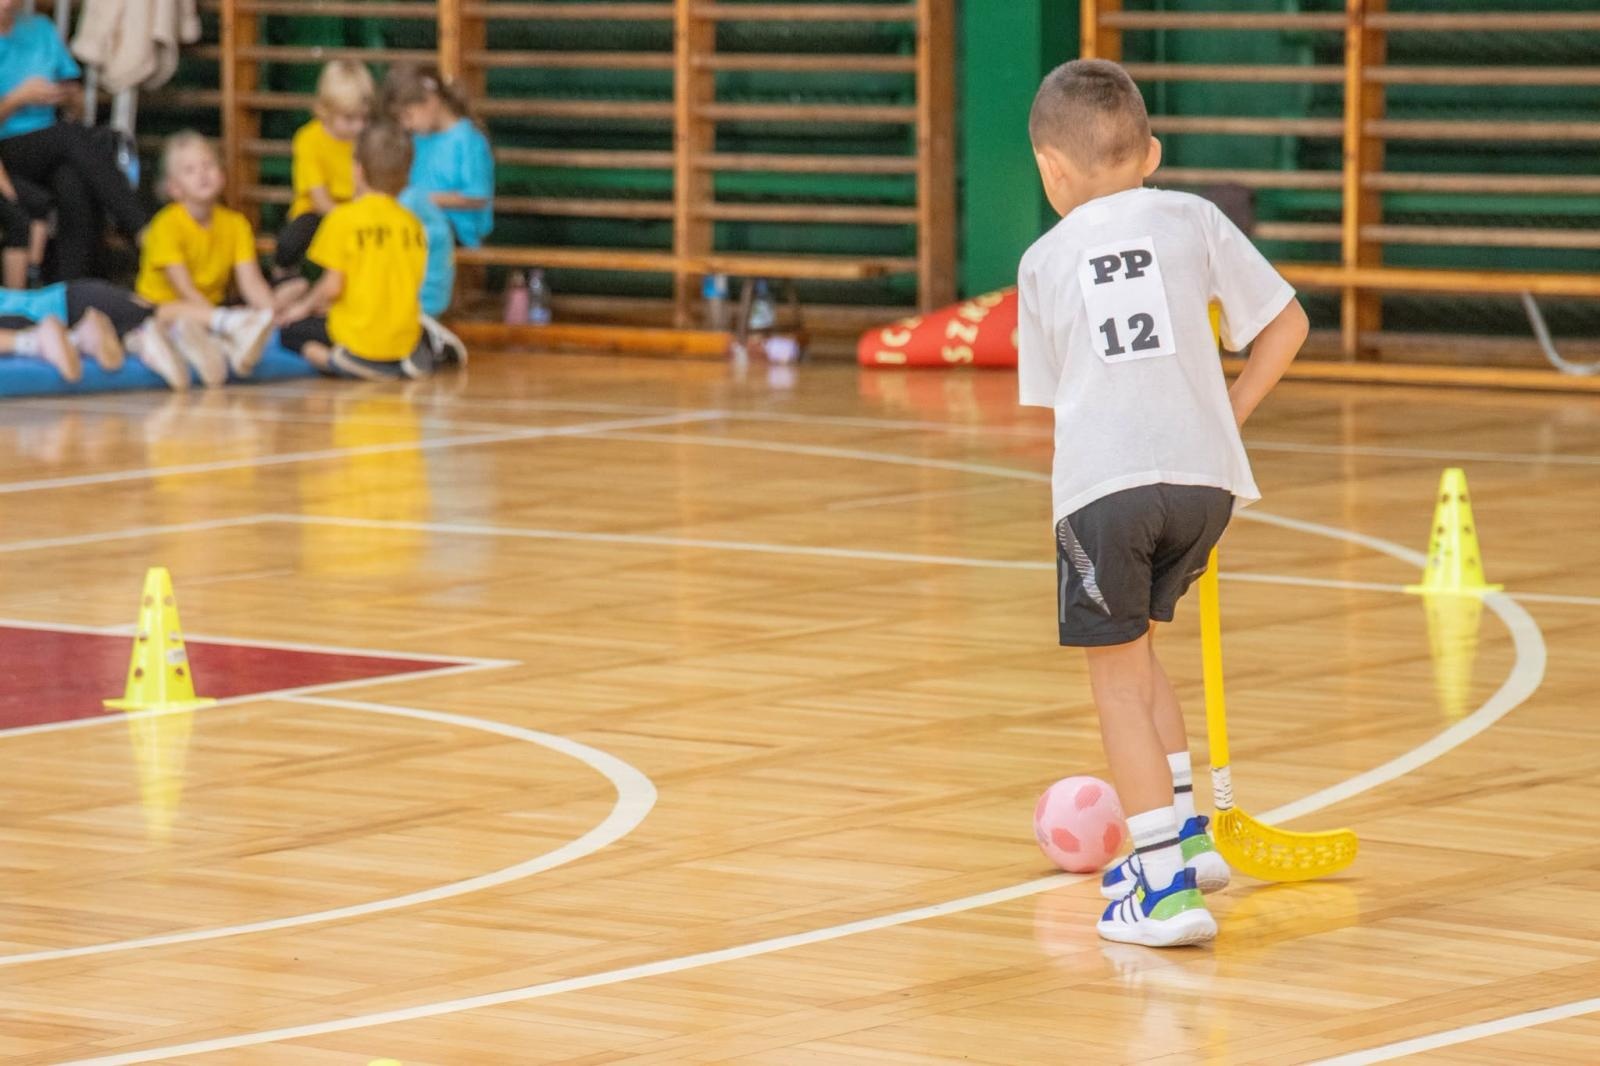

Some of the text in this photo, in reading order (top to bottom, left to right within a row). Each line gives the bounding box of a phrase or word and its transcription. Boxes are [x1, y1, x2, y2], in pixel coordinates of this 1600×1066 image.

[355, 225, 392, 251] PP
[1089, 249, 1153, 285] PP
[1099, 313, 1160, 356] 12
